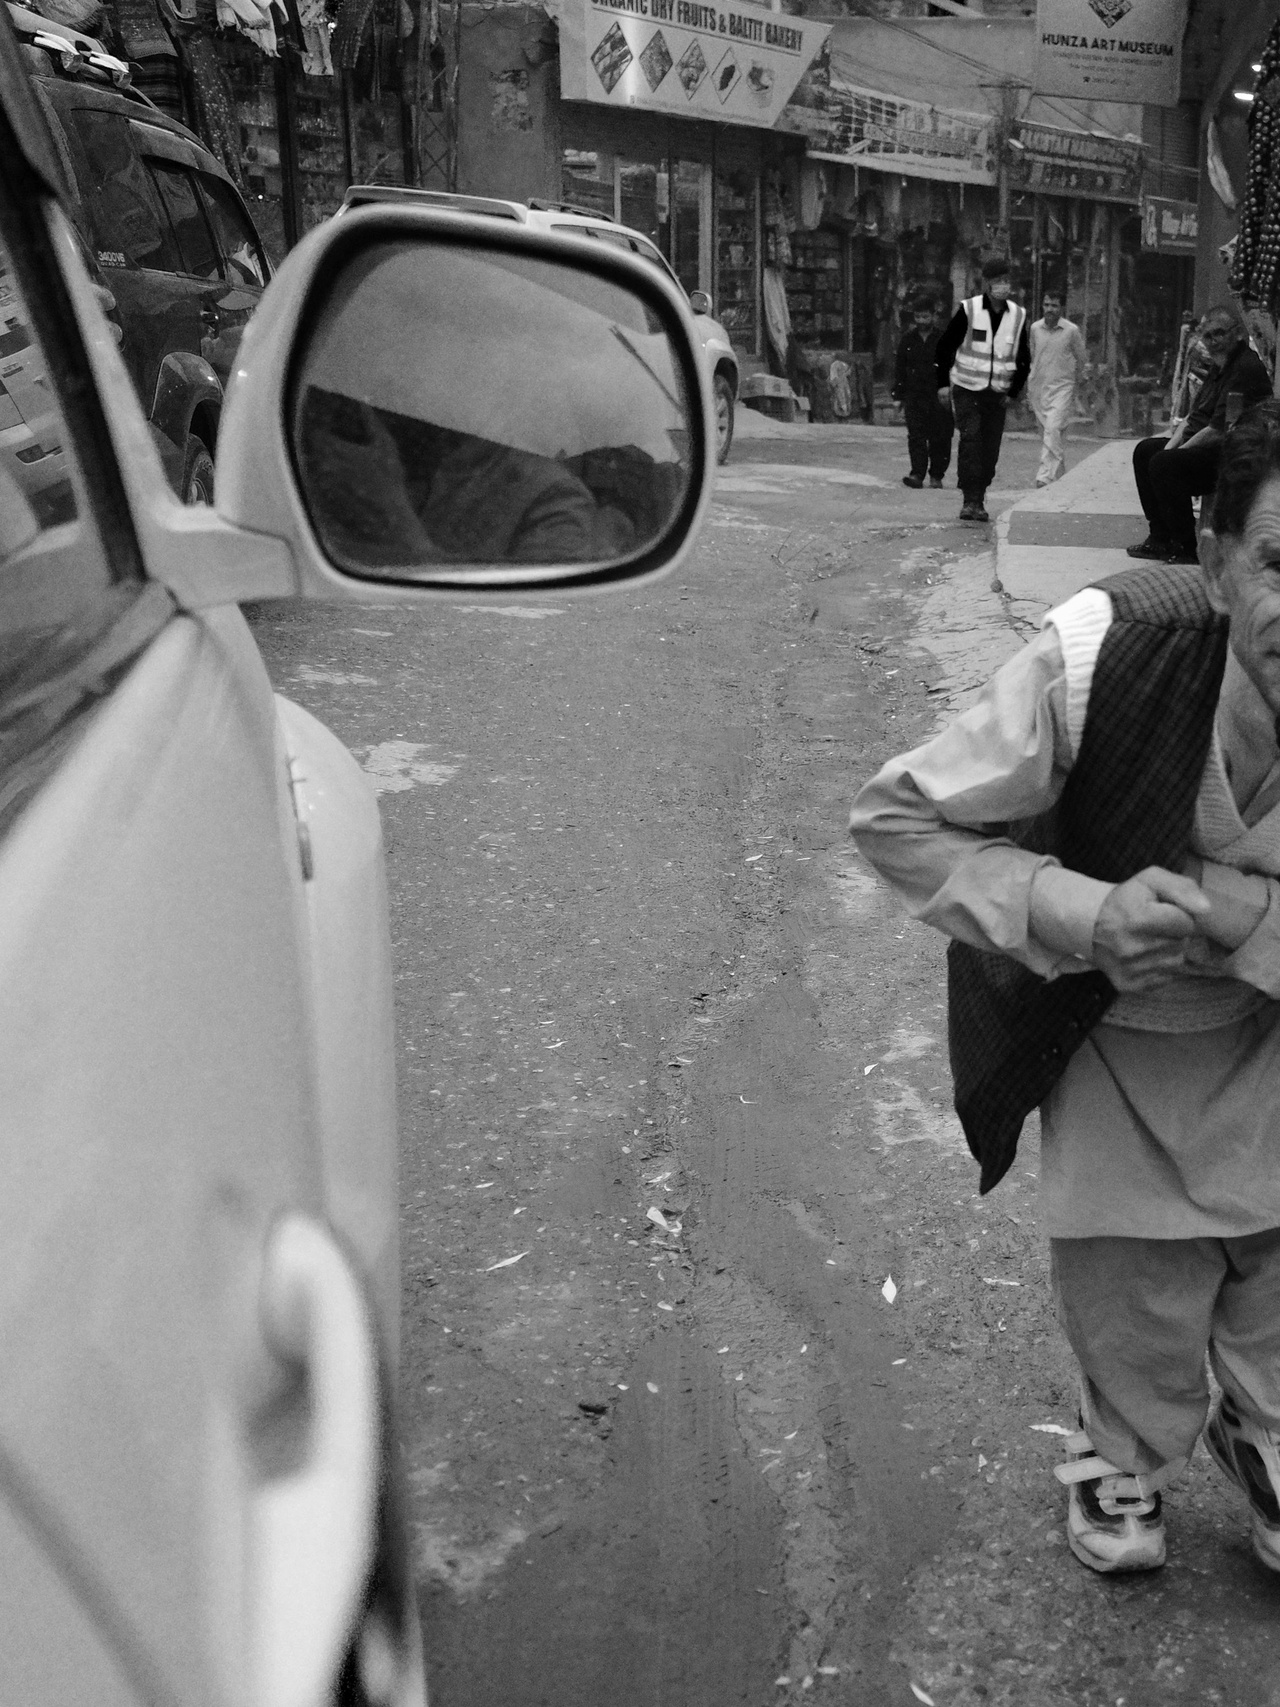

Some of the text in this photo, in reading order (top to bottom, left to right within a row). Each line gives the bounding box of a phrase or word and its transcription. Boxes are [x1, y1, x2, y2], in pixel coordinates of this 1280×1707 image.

[651, 0, 675, 21] DRY
[678, 0, 716, 31] FRUITS
[719, 14, 727, 33] &
[729, 13, 763, 41] BALTIT
[765, 22, 803, 52] BAKERY
[1042, 33, 1174, 56] HUNZA ART MUSEUM
